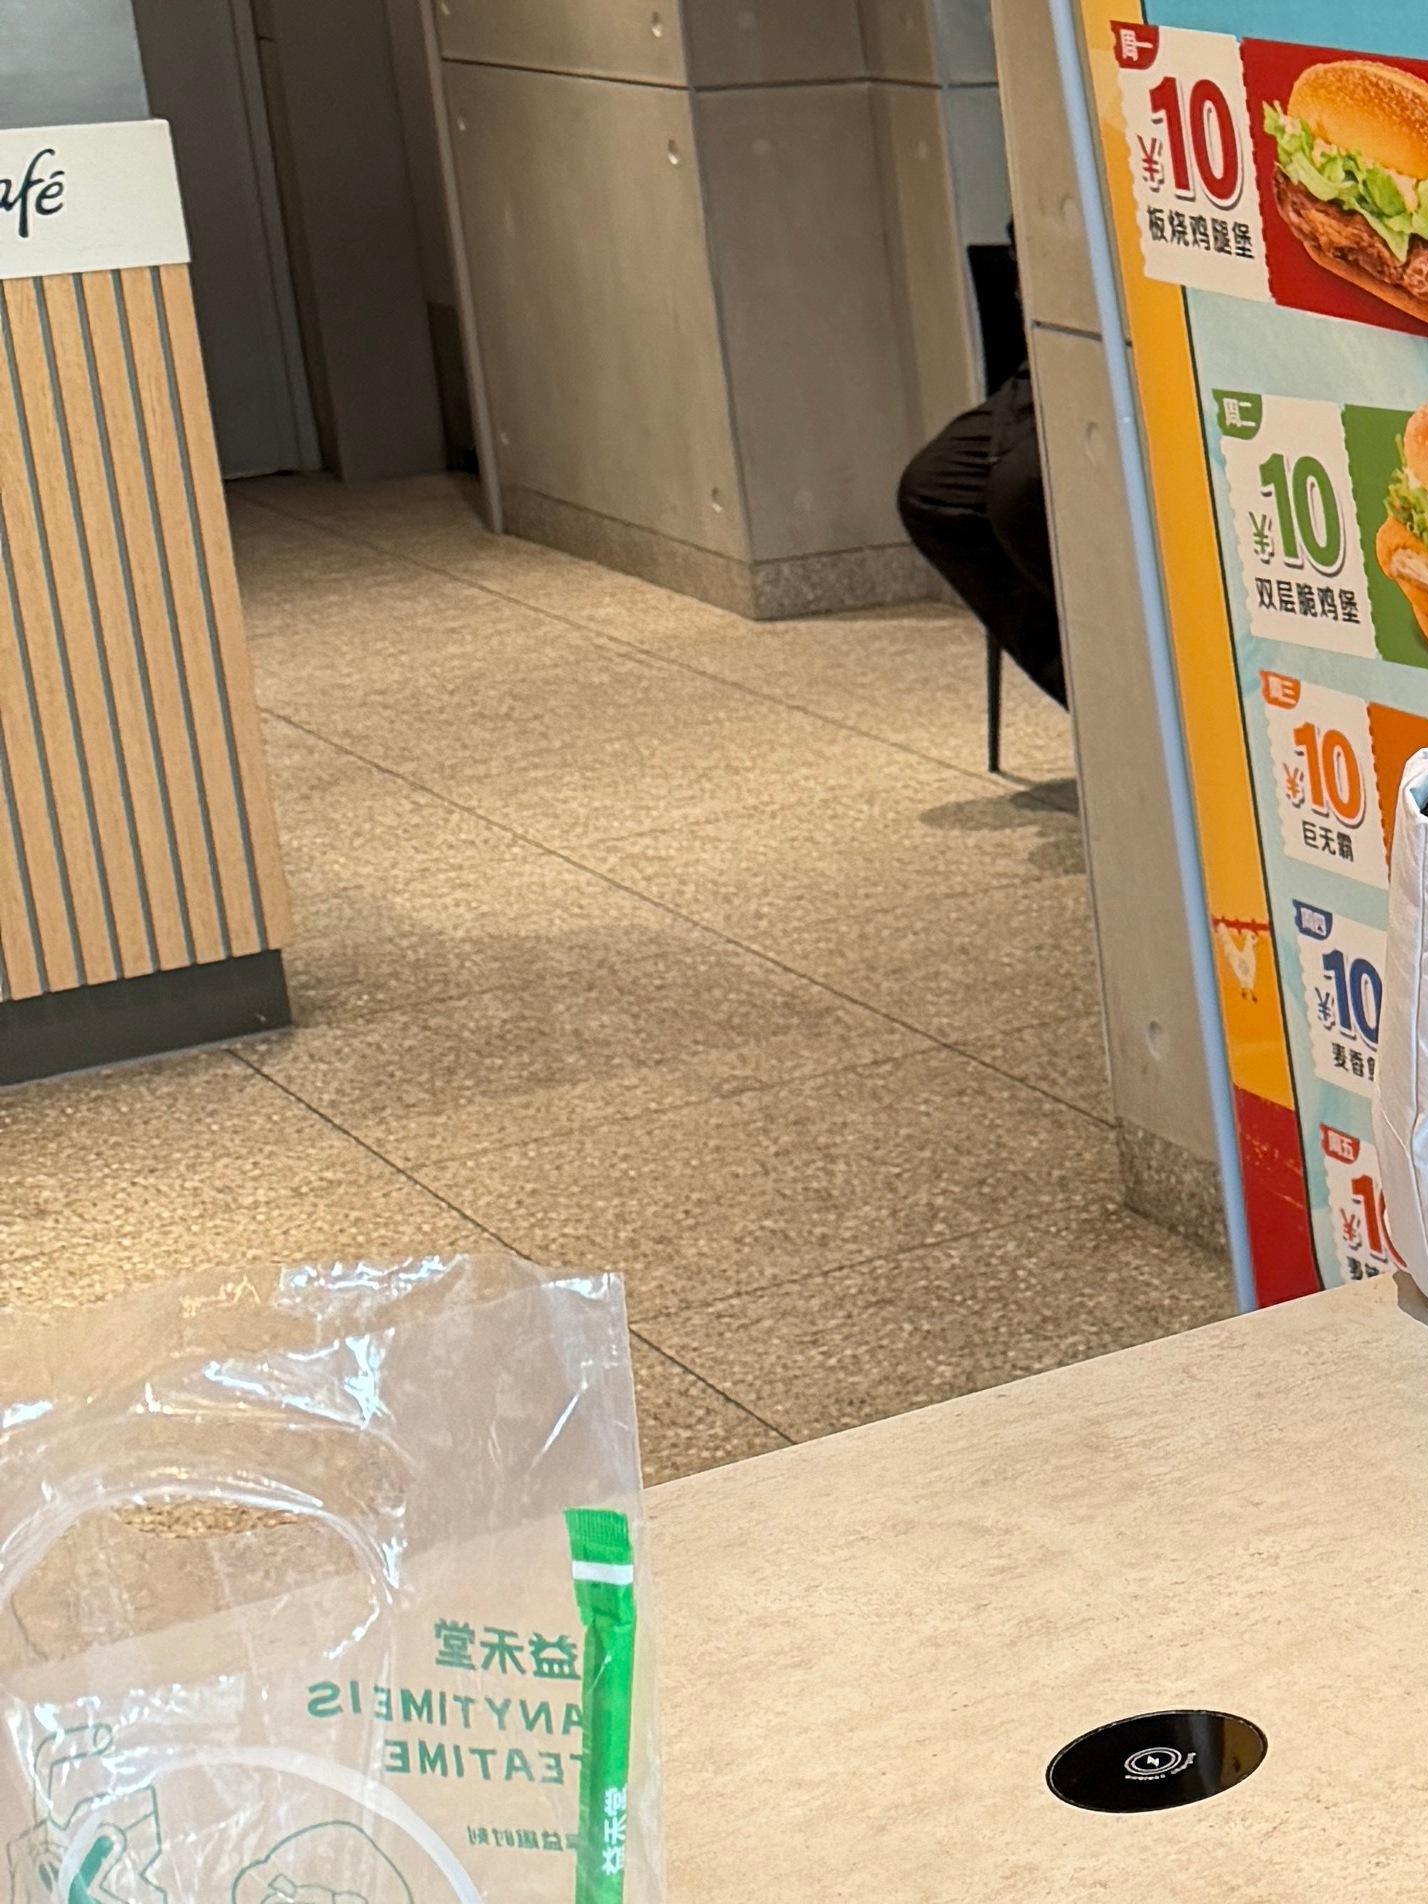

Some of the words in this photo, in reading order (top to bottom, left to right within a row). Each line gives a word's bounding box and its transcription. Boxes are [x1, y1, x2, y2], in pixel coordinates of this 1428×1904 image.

[1147, 206, 1255, 259] 板烧鸡腿堡
[1254, 576, 1361, 624] 双层脆鸡堡
[1302, 820, 1354, 863] 巨无霸
[601, 1786, 628, 1875] 益禾堂
